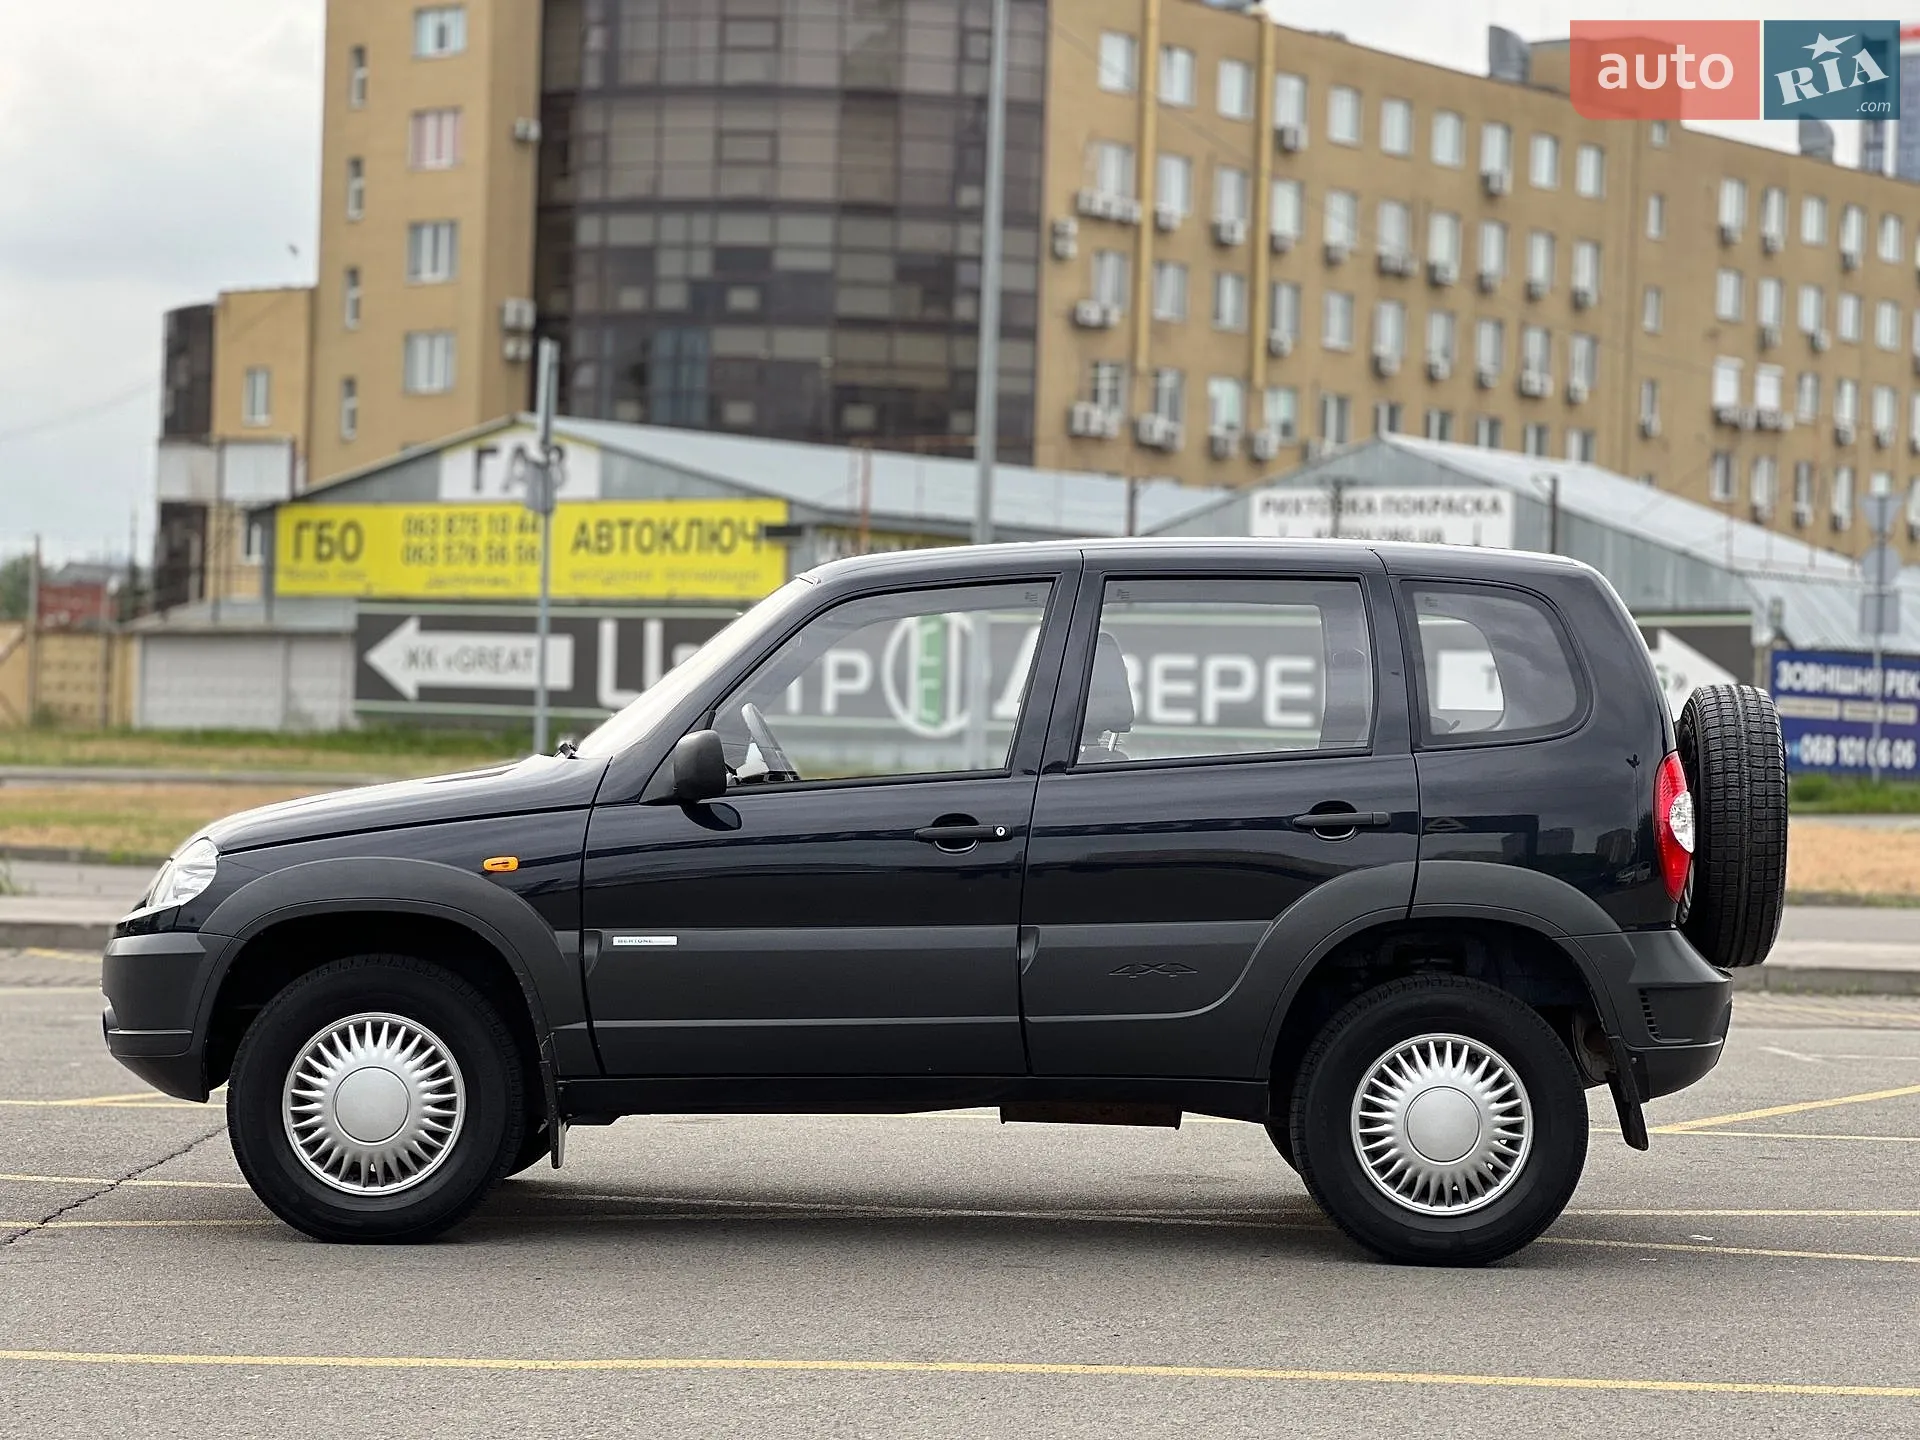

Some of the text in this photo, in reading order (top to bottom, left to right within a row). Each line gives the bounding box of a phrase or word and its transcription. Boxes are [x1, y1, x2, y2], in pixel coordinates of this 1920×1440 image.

[1383, 497, 1503, 517] ПОКРАСКА
[292, 518, 365, 564] ГБО
[570, 518, 763, 555] АВТОКЛЮЧ
